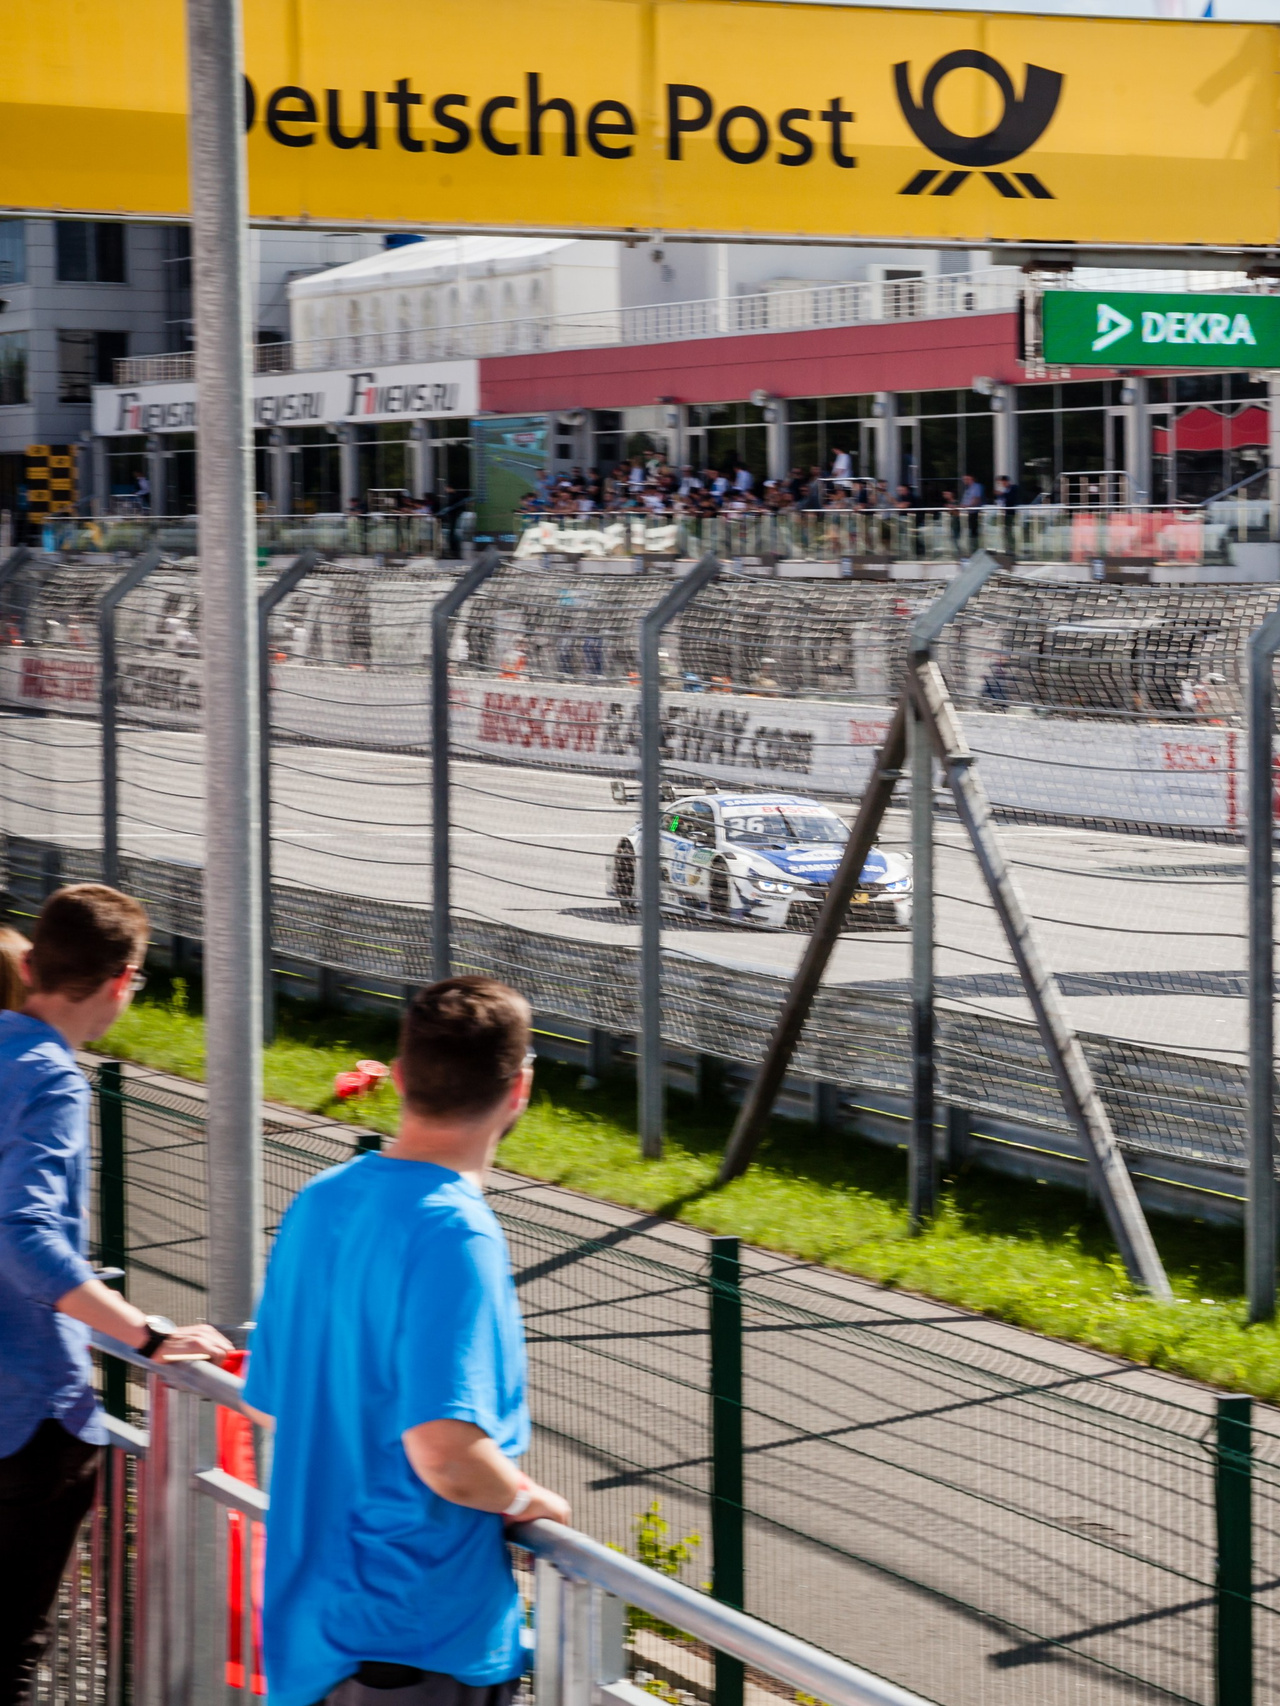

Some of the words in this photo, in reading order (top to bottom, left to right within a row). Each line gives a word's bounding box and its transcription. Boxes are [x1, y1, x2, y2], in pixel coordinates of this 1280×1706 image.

[241, 72, 637, 160] eutsche
[665, 83, 859, 169] Post
[1141, 311, 1257, 345] DEKRA
[253, 392, 326, 421] NEWS.RU
[761, 806, 820, 814] BOSCH
[789, 863, 841, 874] SAMSU
